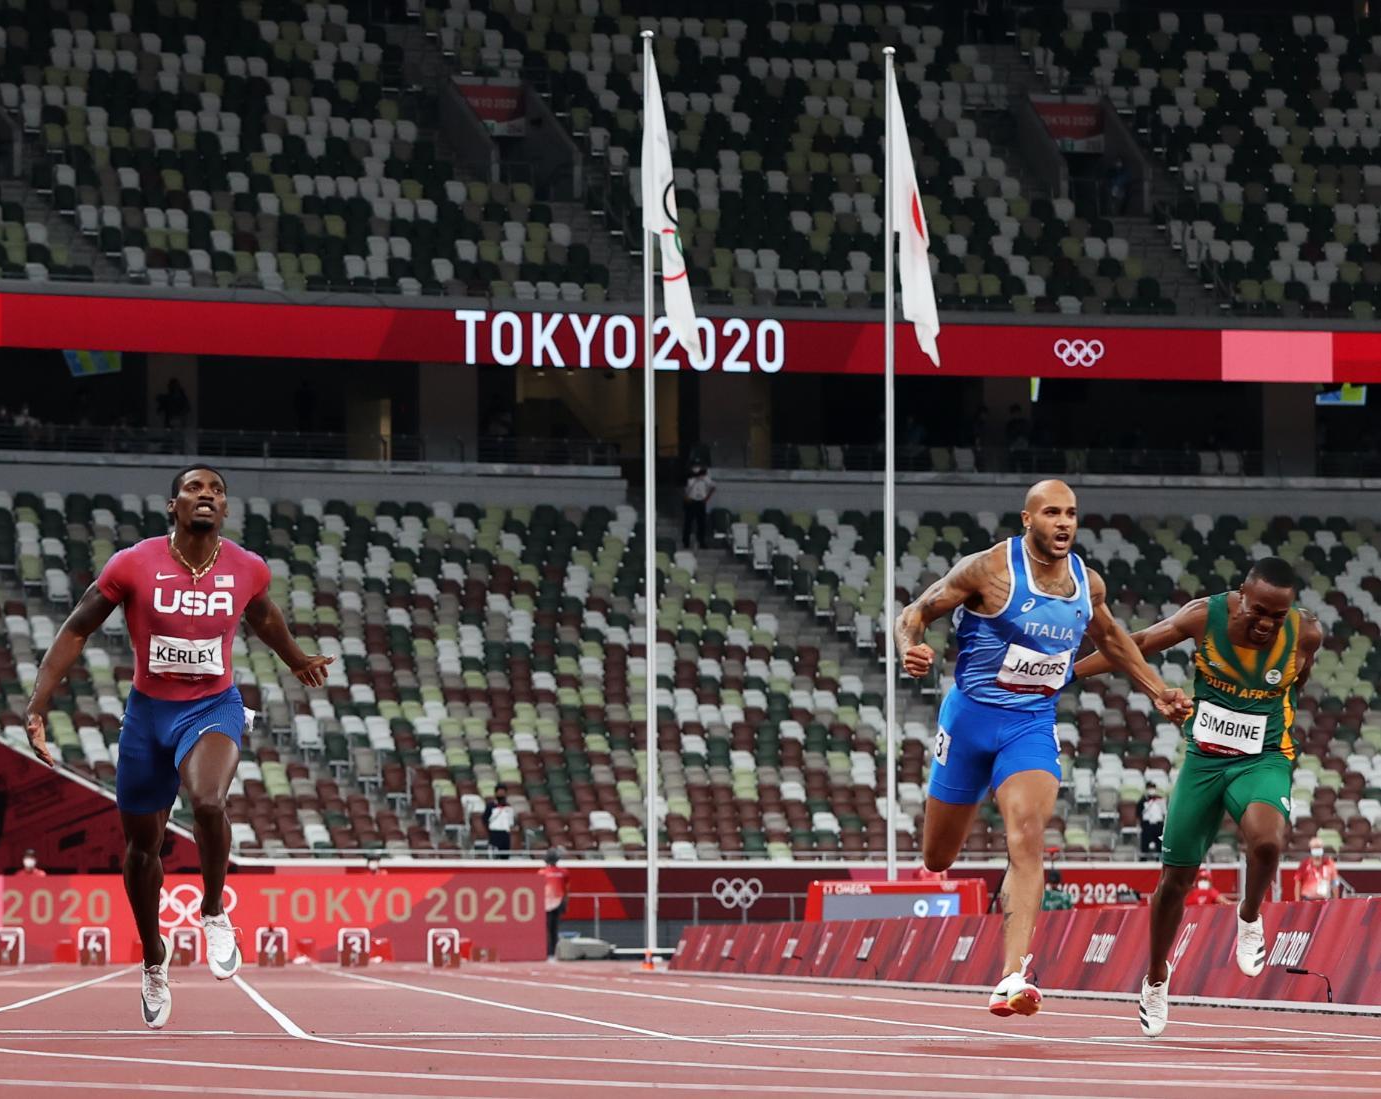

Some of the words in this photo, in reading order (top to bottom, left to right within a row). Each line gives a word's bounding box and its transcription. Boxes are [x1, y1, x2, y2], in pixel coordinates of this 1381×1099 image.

[455, 310, 636, 369] TOKYO
[653, 316, 785, 374] 2020
[154, 588, 233, 616] USA
[1024, 622, 1074, 641] ITALIA
[156, 645, 215, 664] KERLEY
[1011, 659, 1066, 676] JACOBS
[1205, 674, 1236, 694] OUTH
[1200, 713, 1260, 740] SIMBINE
[1, 889, 111, 925] 2020
[261, 888, 412, 923] TOKYO
[424, 887, 535, 923] 2020
